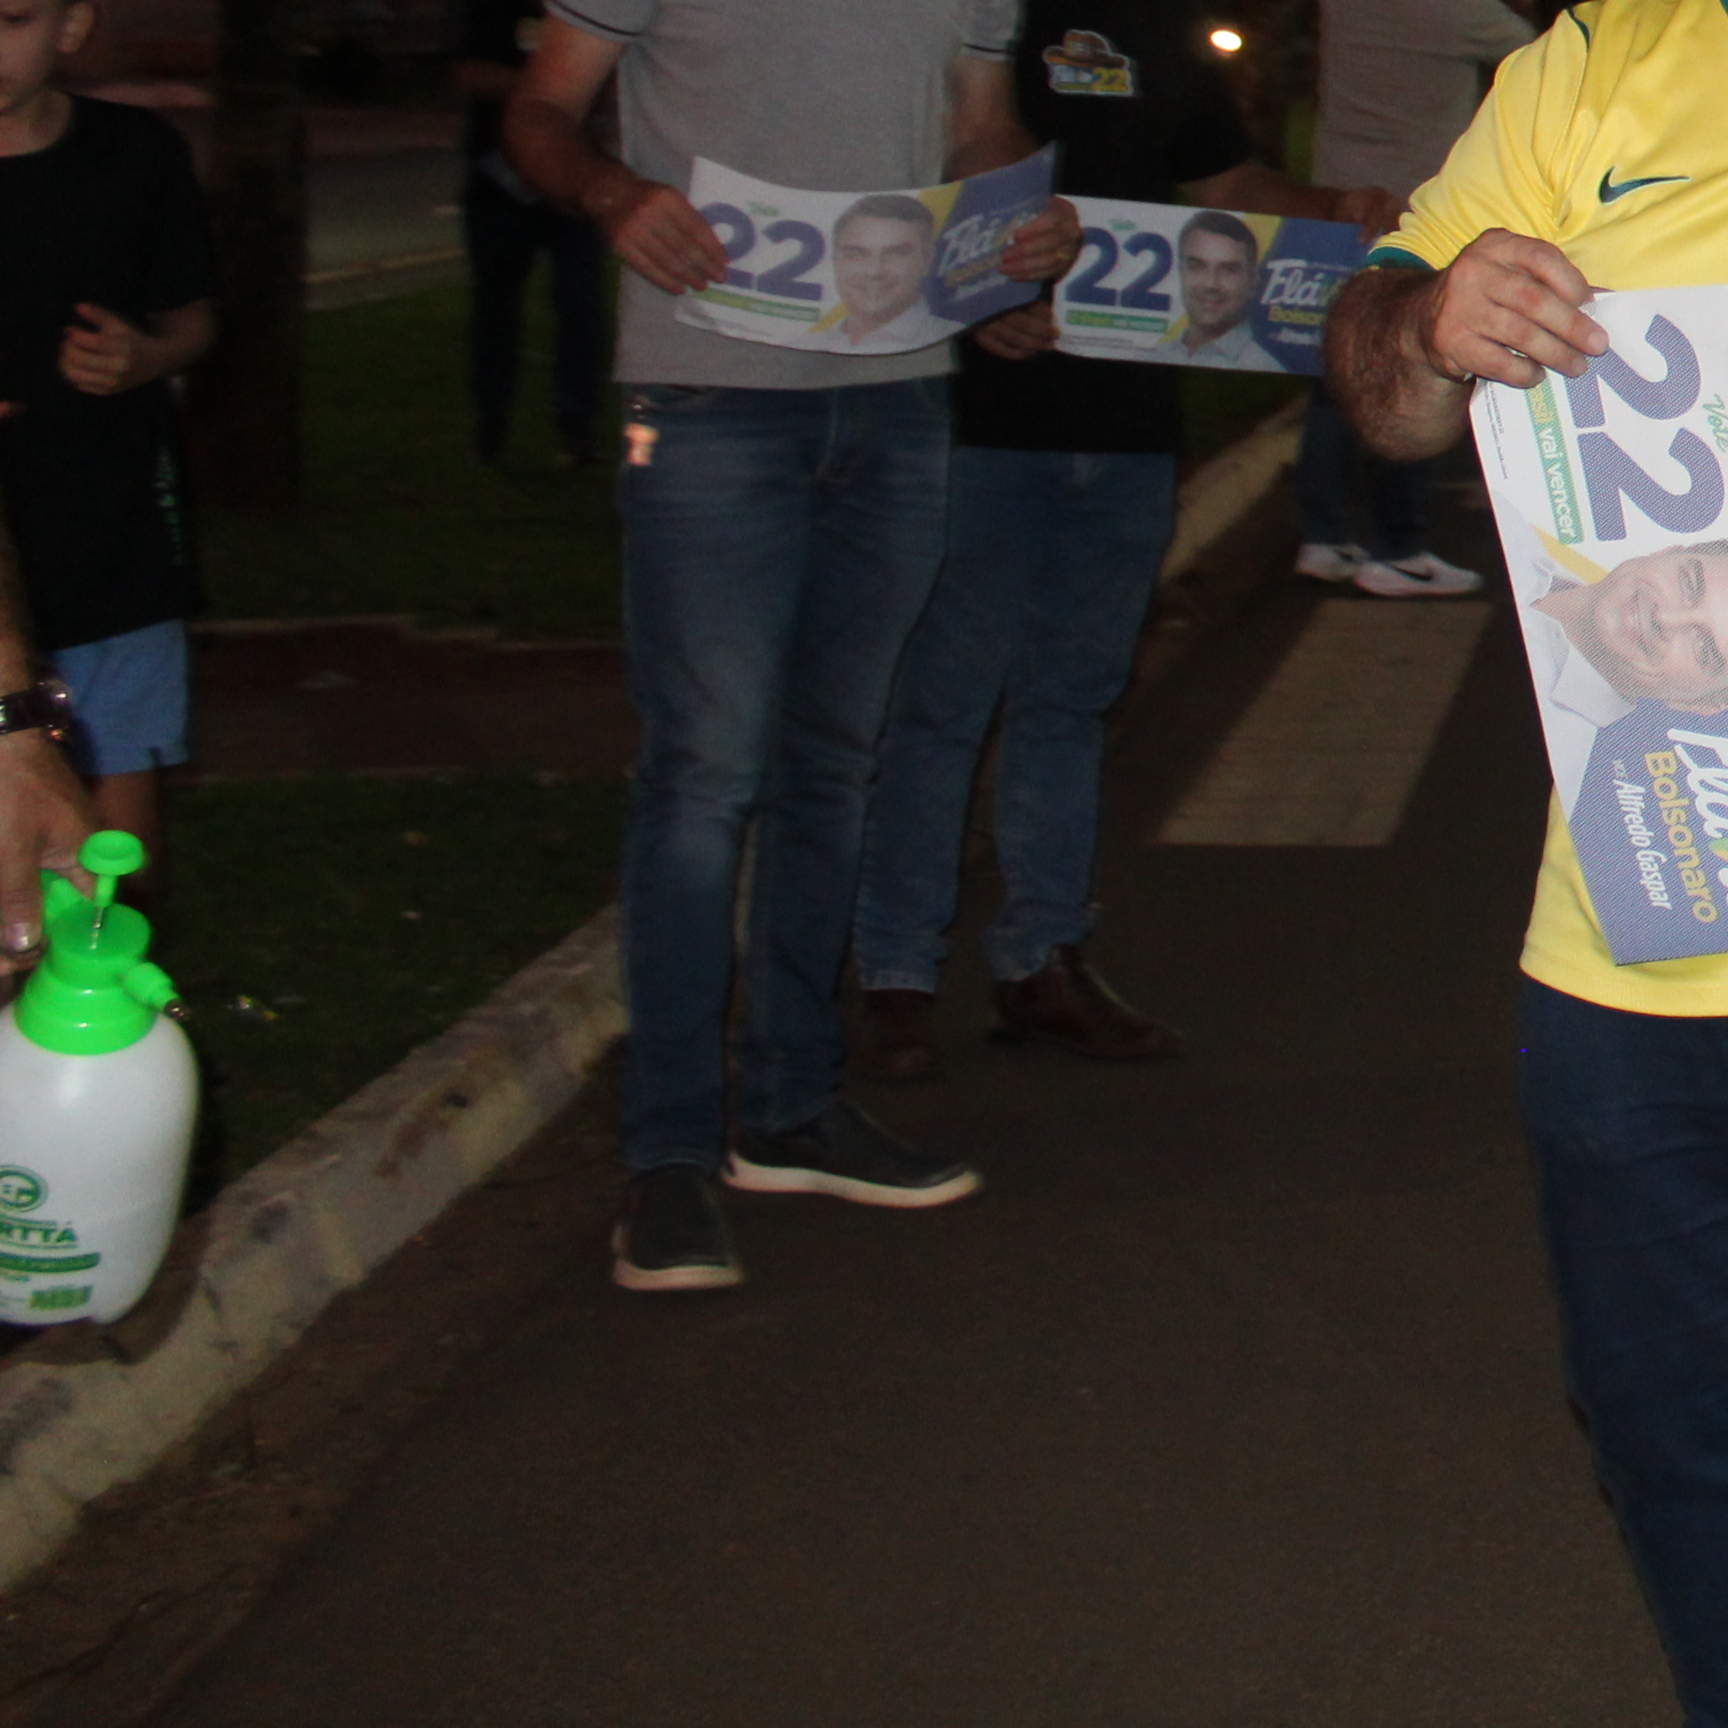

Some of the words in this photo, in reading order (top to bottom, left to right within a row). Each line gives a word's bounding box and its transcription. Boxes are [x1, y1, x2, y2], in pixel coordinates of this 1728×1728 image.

[1065, 227, 1172, 312] 22
[1538, 427, 1562, 459] vai
[1563, 313, 1726, 542] 22
[1547, 462, 1577, 539] vencer
[1612, 779, 1655, 848] Alfredo
[1635, 849, 1673, 911] Gaspar
[1644, 750, 1719, 924] Bolsonaro
